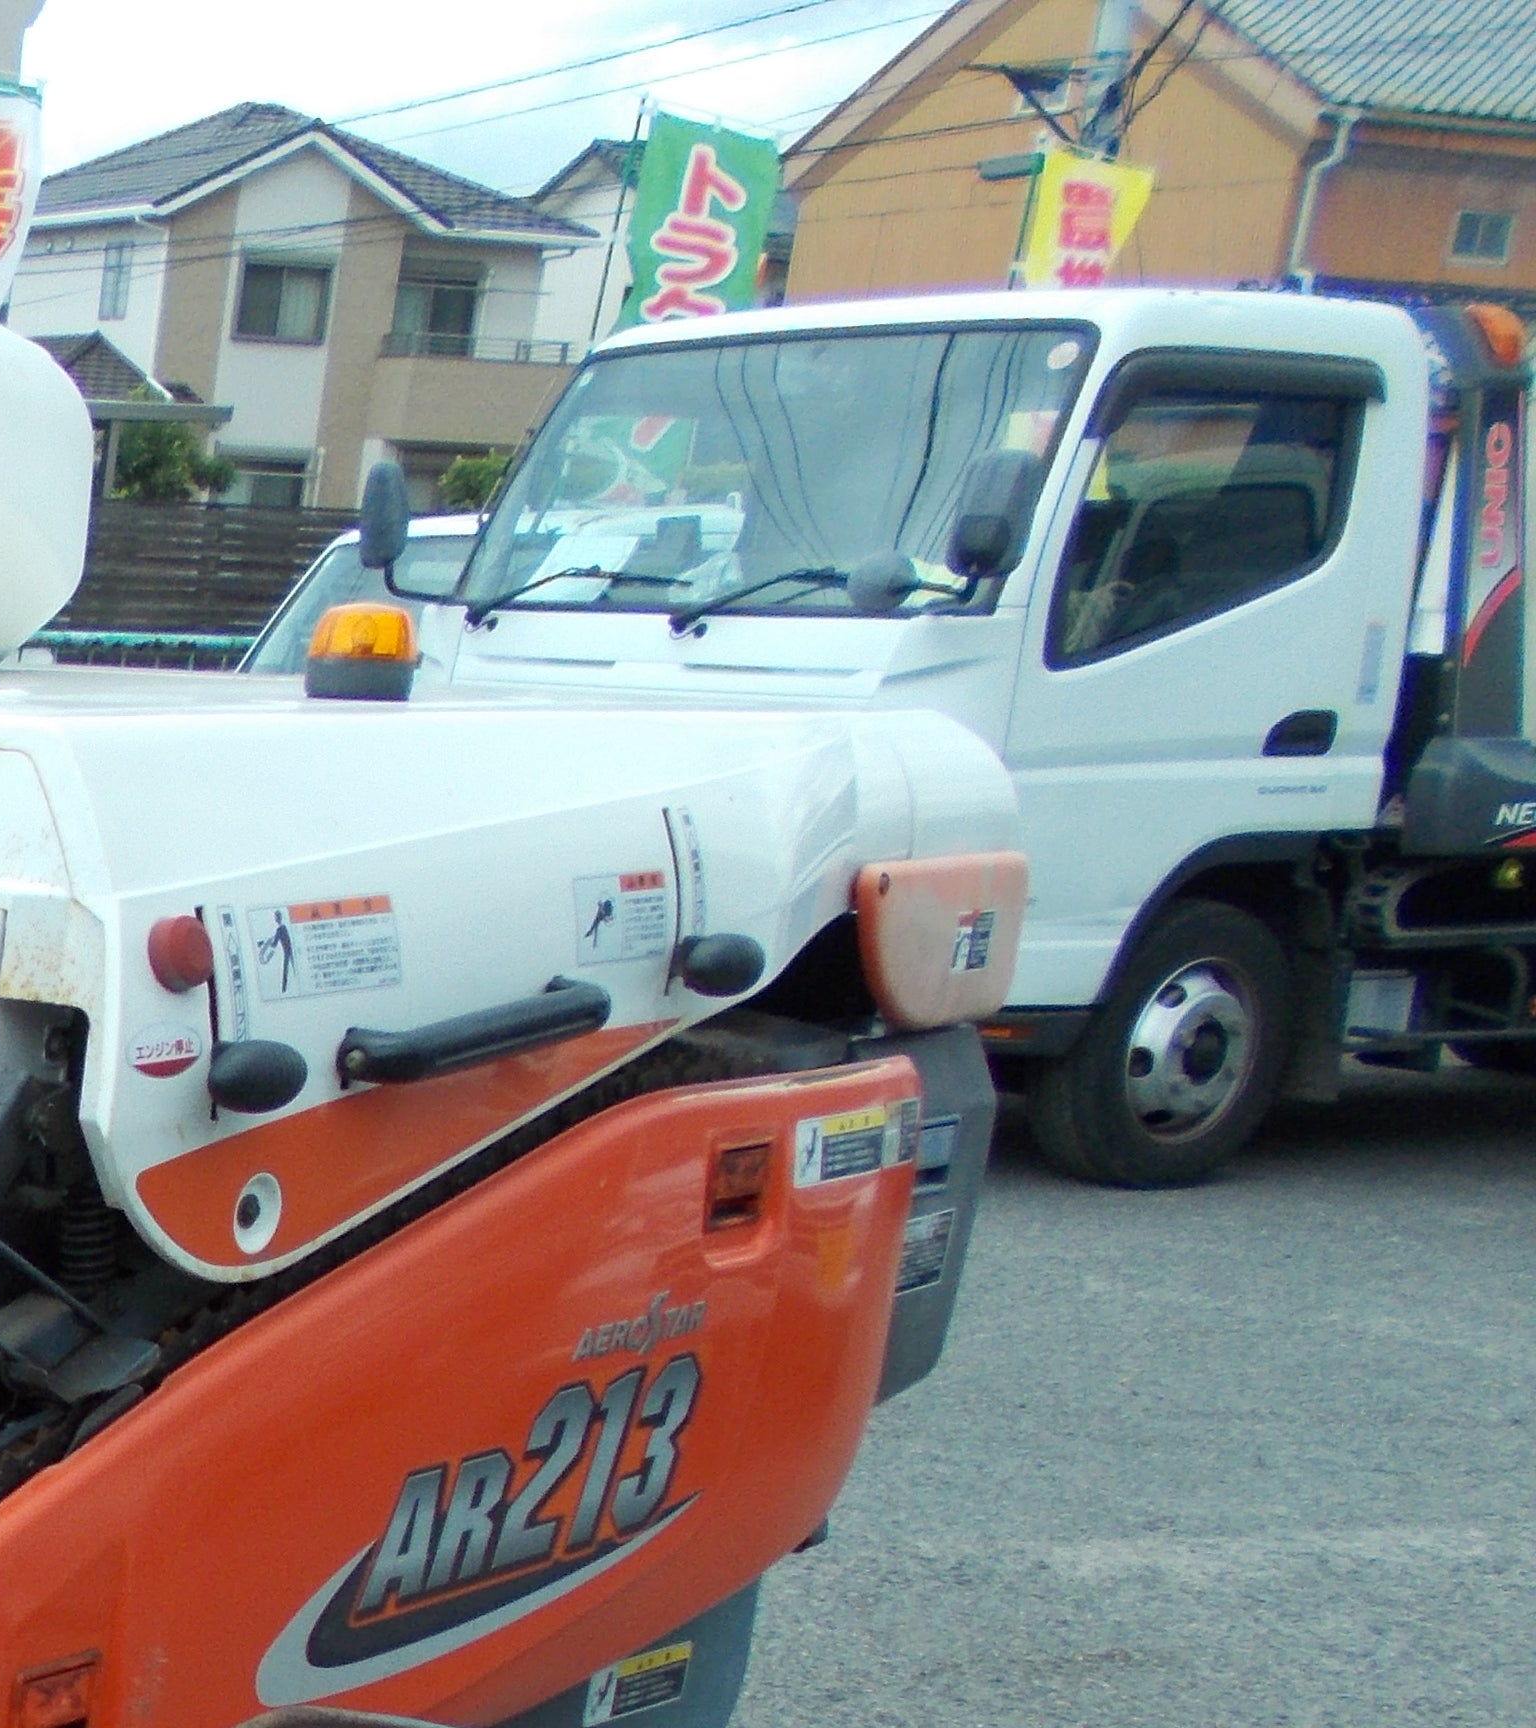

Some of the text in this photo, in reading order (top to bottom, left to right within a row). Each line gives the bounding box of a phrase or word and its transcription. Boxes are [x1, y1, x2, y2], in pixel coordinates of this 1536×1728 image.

[1481, 421, 1513, 567] UNIC
[136, 1038, 194, 1059] エンジン停止
[572, 1290, 706, 1362] AEROSTAR
[354, 1352, 702, 1617] AR213
